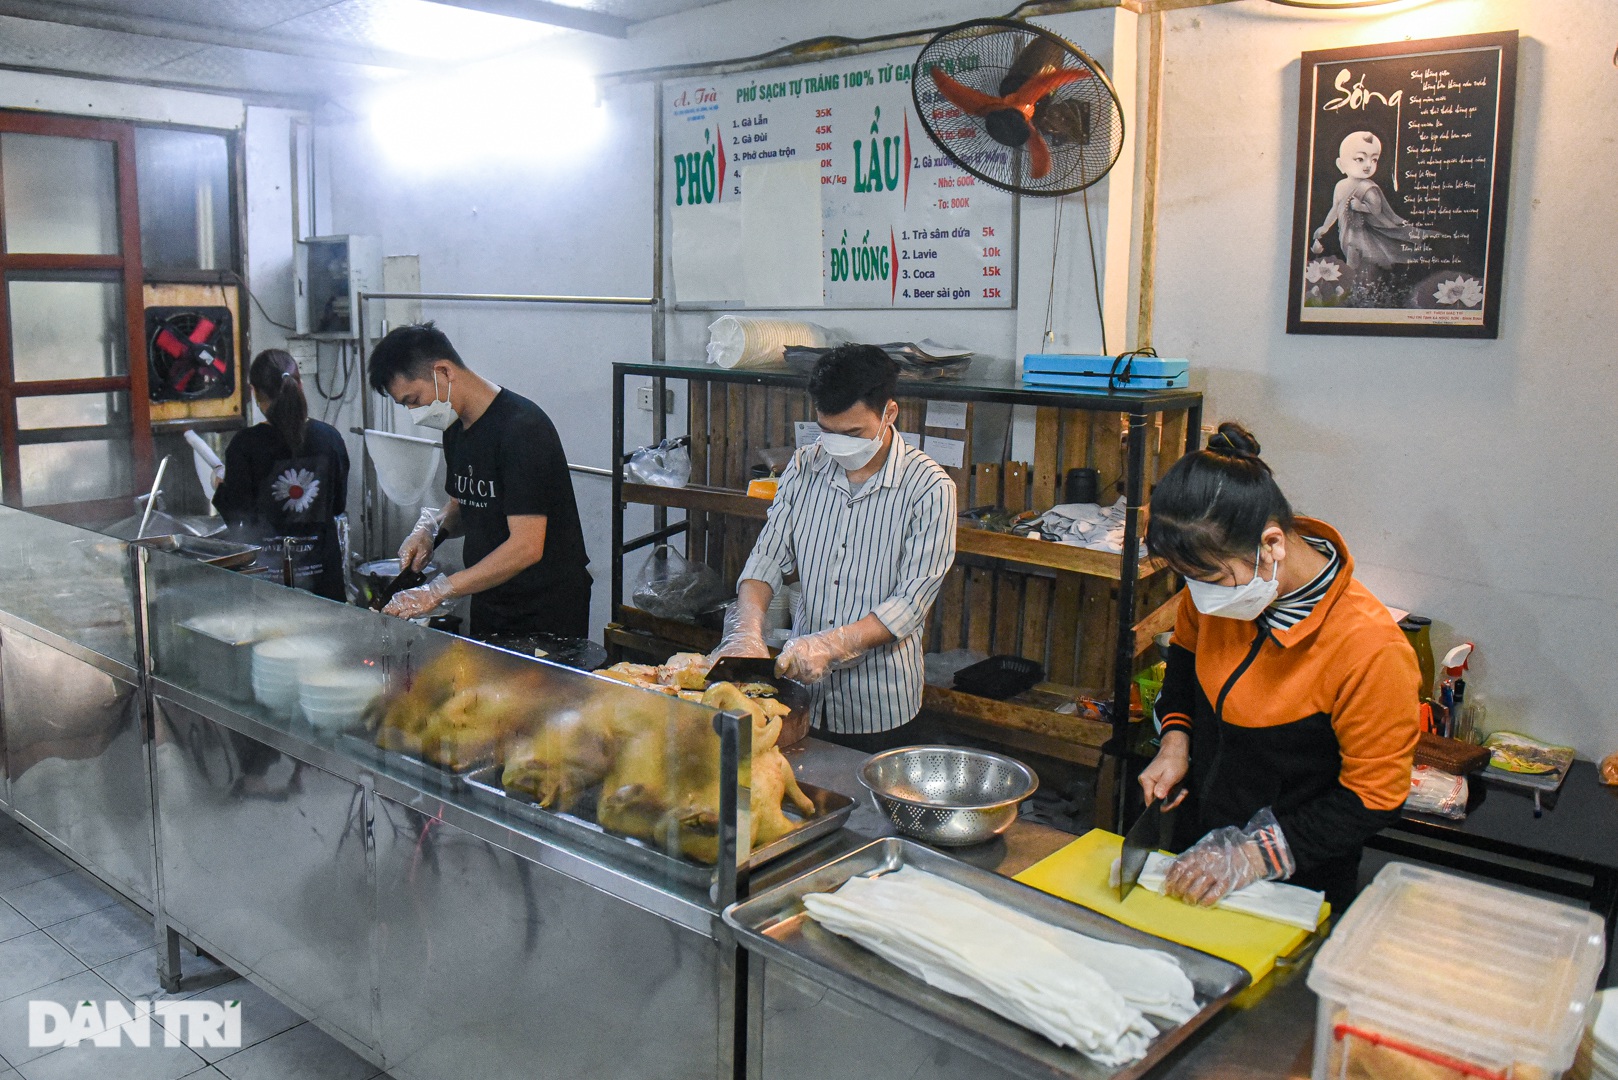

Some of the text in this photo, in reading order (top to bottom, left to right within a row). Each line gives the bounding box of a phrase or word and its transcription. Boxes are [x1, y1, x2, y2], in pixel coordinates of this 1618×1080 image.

[736, 80, 757, 103] PHỞ
[759, 82, 786, 103] SẠCH
[789, 78, 803, 99] TỰ
[843, 70, 874, 88] 100%
[878, 63, 893, 83] TỪ
[695, 87, 717, 104] Trà
[732, 120, 740, 128] 1.
[741, 117, 751, 127] Gà
[815, 108, 832, 118] 35K
[733, 125, 832, 145] 2. Gà Đùi 45K
[733, 142, 832, 161] 3. Phở chua trộn 50K
[853, 105, 900, 193] LẨU
[674, 127, 716, 206] PHỞ
[733, 159, 833, 178] 4. 0K
[914, 158, 921, 168] 2.
[922, 154, 933, 168] Gà
[734, 174, 847, 195] 5. 0K/kg
[938, 176, 955, 188] Nhỏ:
[938, 199, 949, 210] To:
[951, 197, 970, 208] 800K
[902, 226, 995, 240] 1. Trà sâm dứa 5k
[830, 229, 889, 282] ĐỒ UỐNG
[902, 247, 1001, 260] 2. Lavie 10k
[902, 266, 1001, 279] 3. Coca 15k
[902, 287, 1001, 300] 4. Beer sài gòn 15k
[455, 474, 496, 498] UCCI
